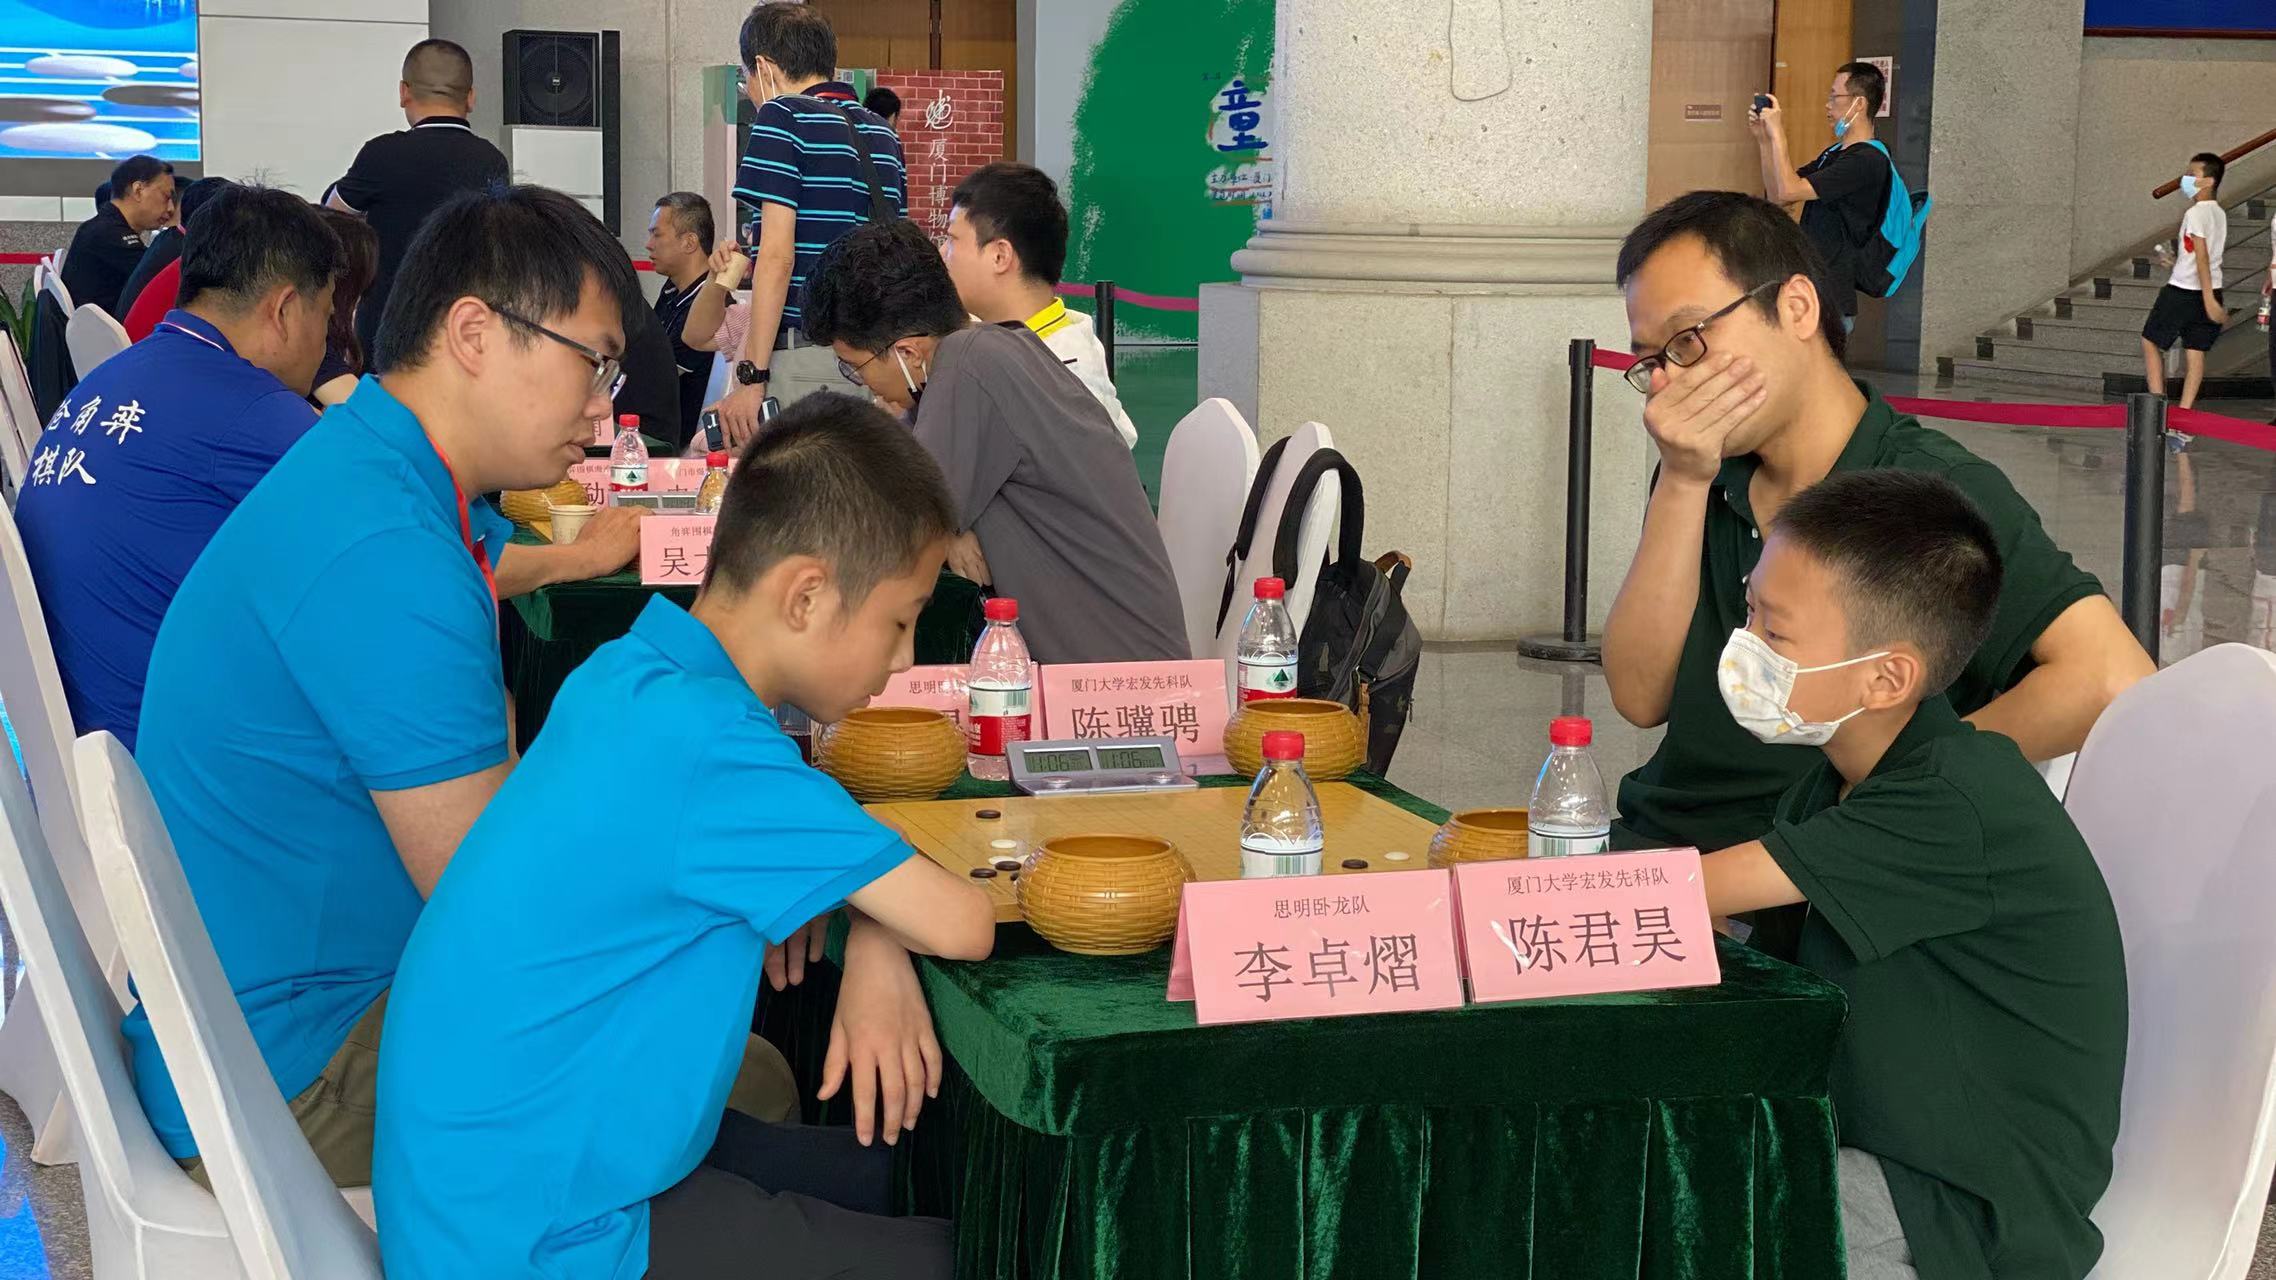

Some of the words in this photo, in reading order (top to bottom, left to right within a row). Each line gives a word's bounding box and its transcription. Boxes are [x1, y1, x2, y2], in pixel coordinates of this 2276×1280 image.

[1217, 80, 1269, 152] 童
[1071, 674, 1193, 693] 厦门大学宏发先科队
[1071, 702, 1201, 744] 陈骥骋
[1507, 866, 1669, 896] 厦门大学宏发先科队
[1274, 894, 1371, 920] 思明卧龙队
[1508, 905, 1687, 976] 陈君昊
[1233, 933, 1421, 1003] 李卓熠
